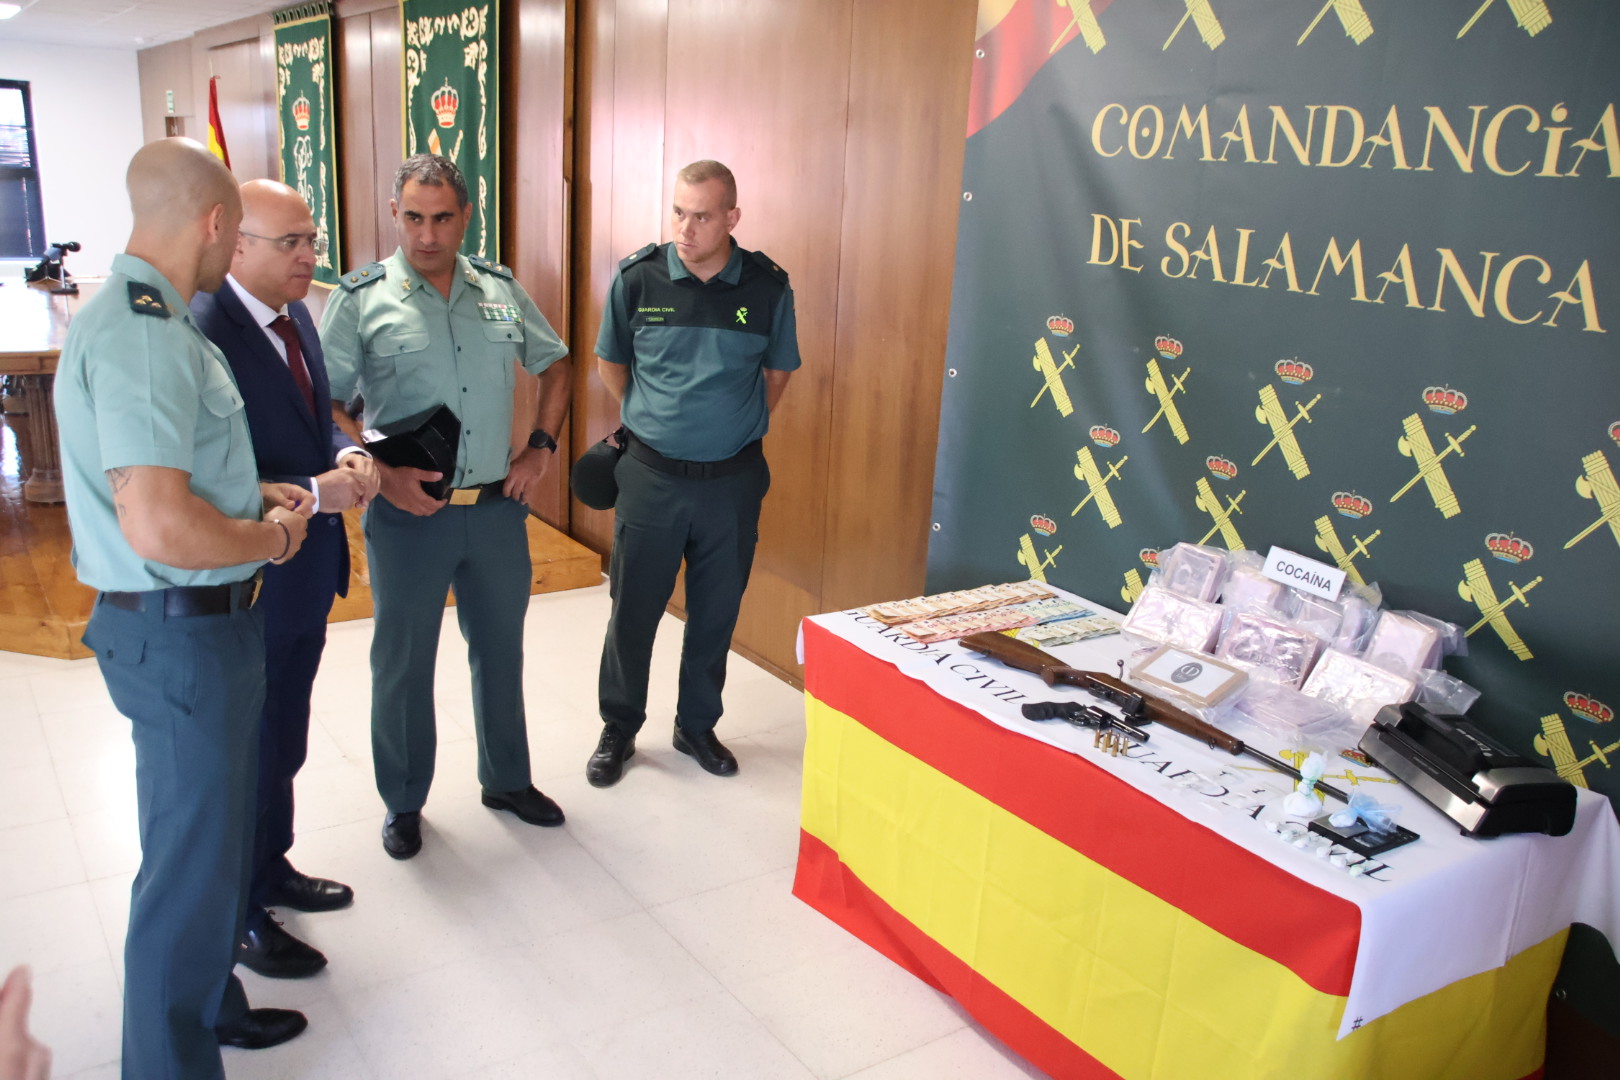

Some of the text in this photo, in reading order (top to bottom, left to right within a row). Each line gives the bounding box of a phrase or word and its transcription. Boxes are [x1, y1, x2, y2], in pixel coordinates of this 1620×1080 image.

[1086, 213, 1607, 333] DE SALAMANCA
[1276, 560, 1331, 592] COCAÍNA
[950, 664, 1029, 704] CIVIL
